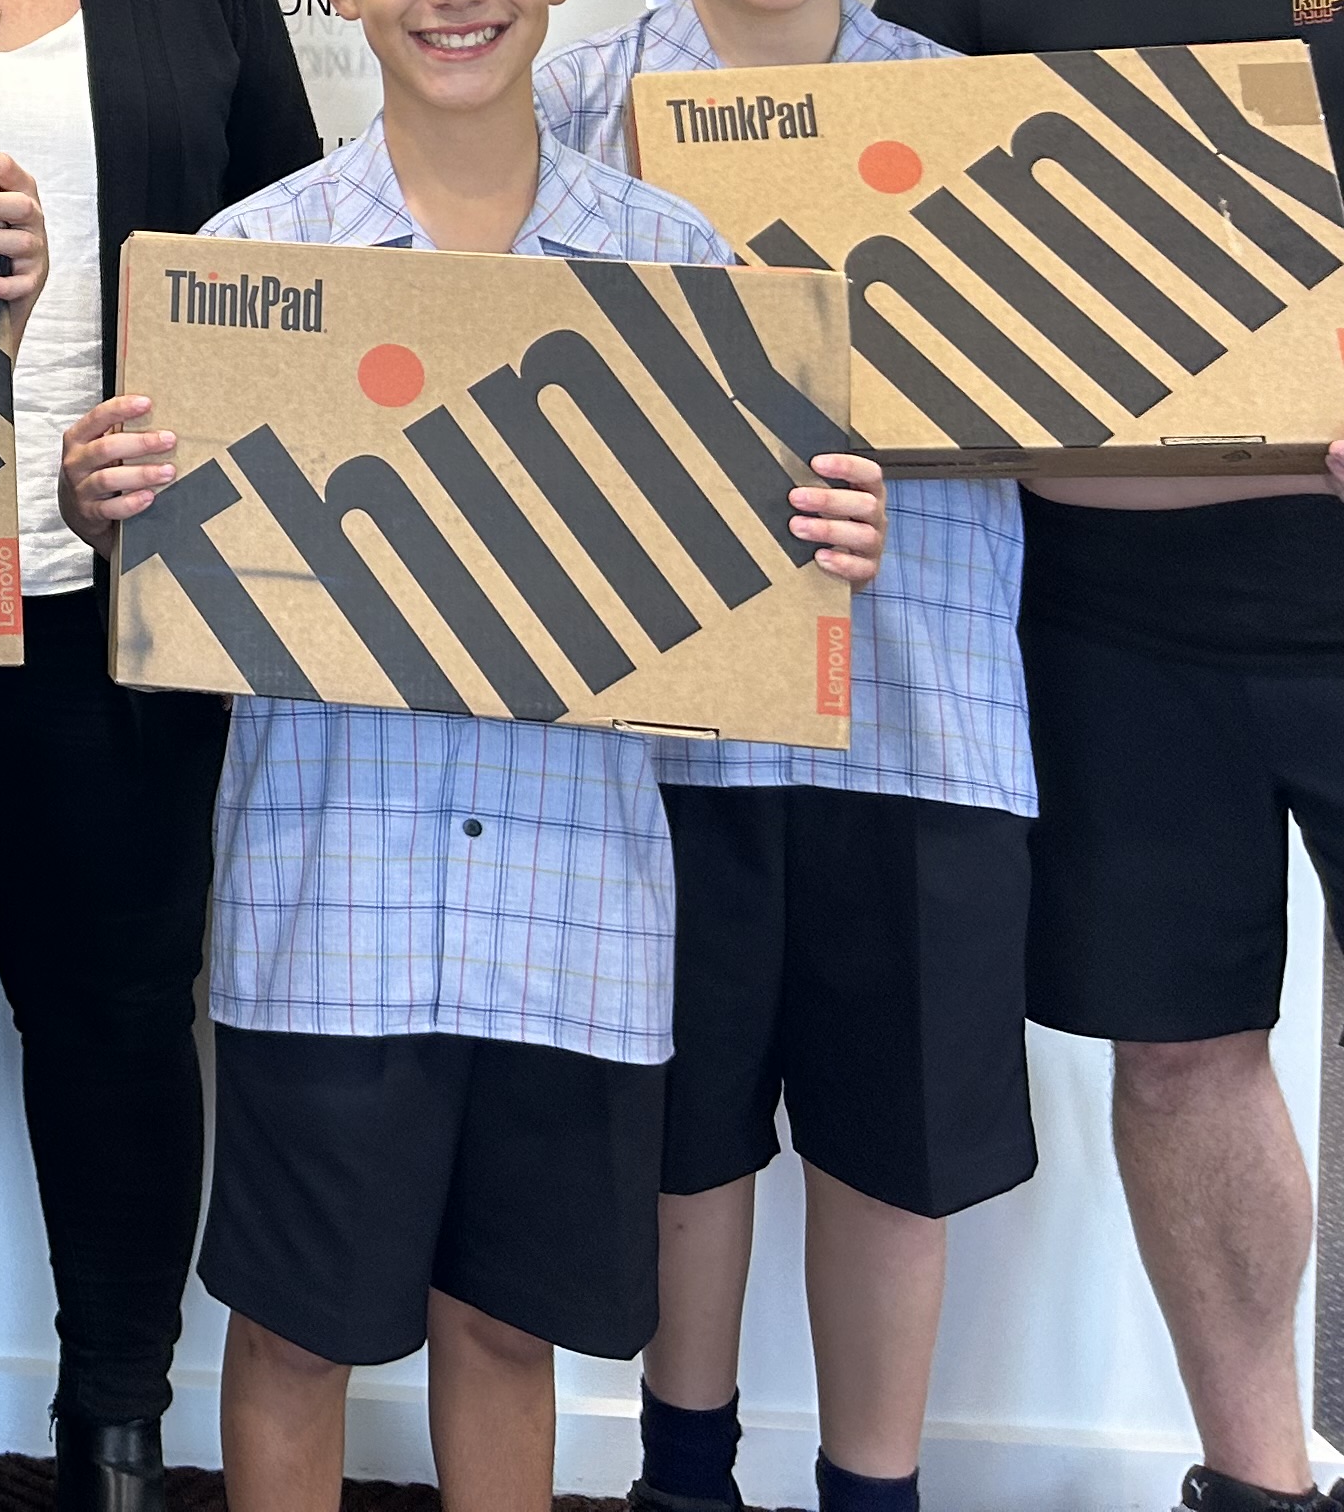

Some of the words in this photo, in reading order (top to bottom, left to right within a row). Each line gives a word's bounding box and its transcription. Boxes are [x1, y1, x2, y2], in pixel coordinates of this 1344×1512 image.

[666, 92, 818, 144] ThinkPad
[164, 268, 324, 333] ThinkPad
[121, 258, 850, 722] Think
[823, 625, 845, 708] Lenovo
